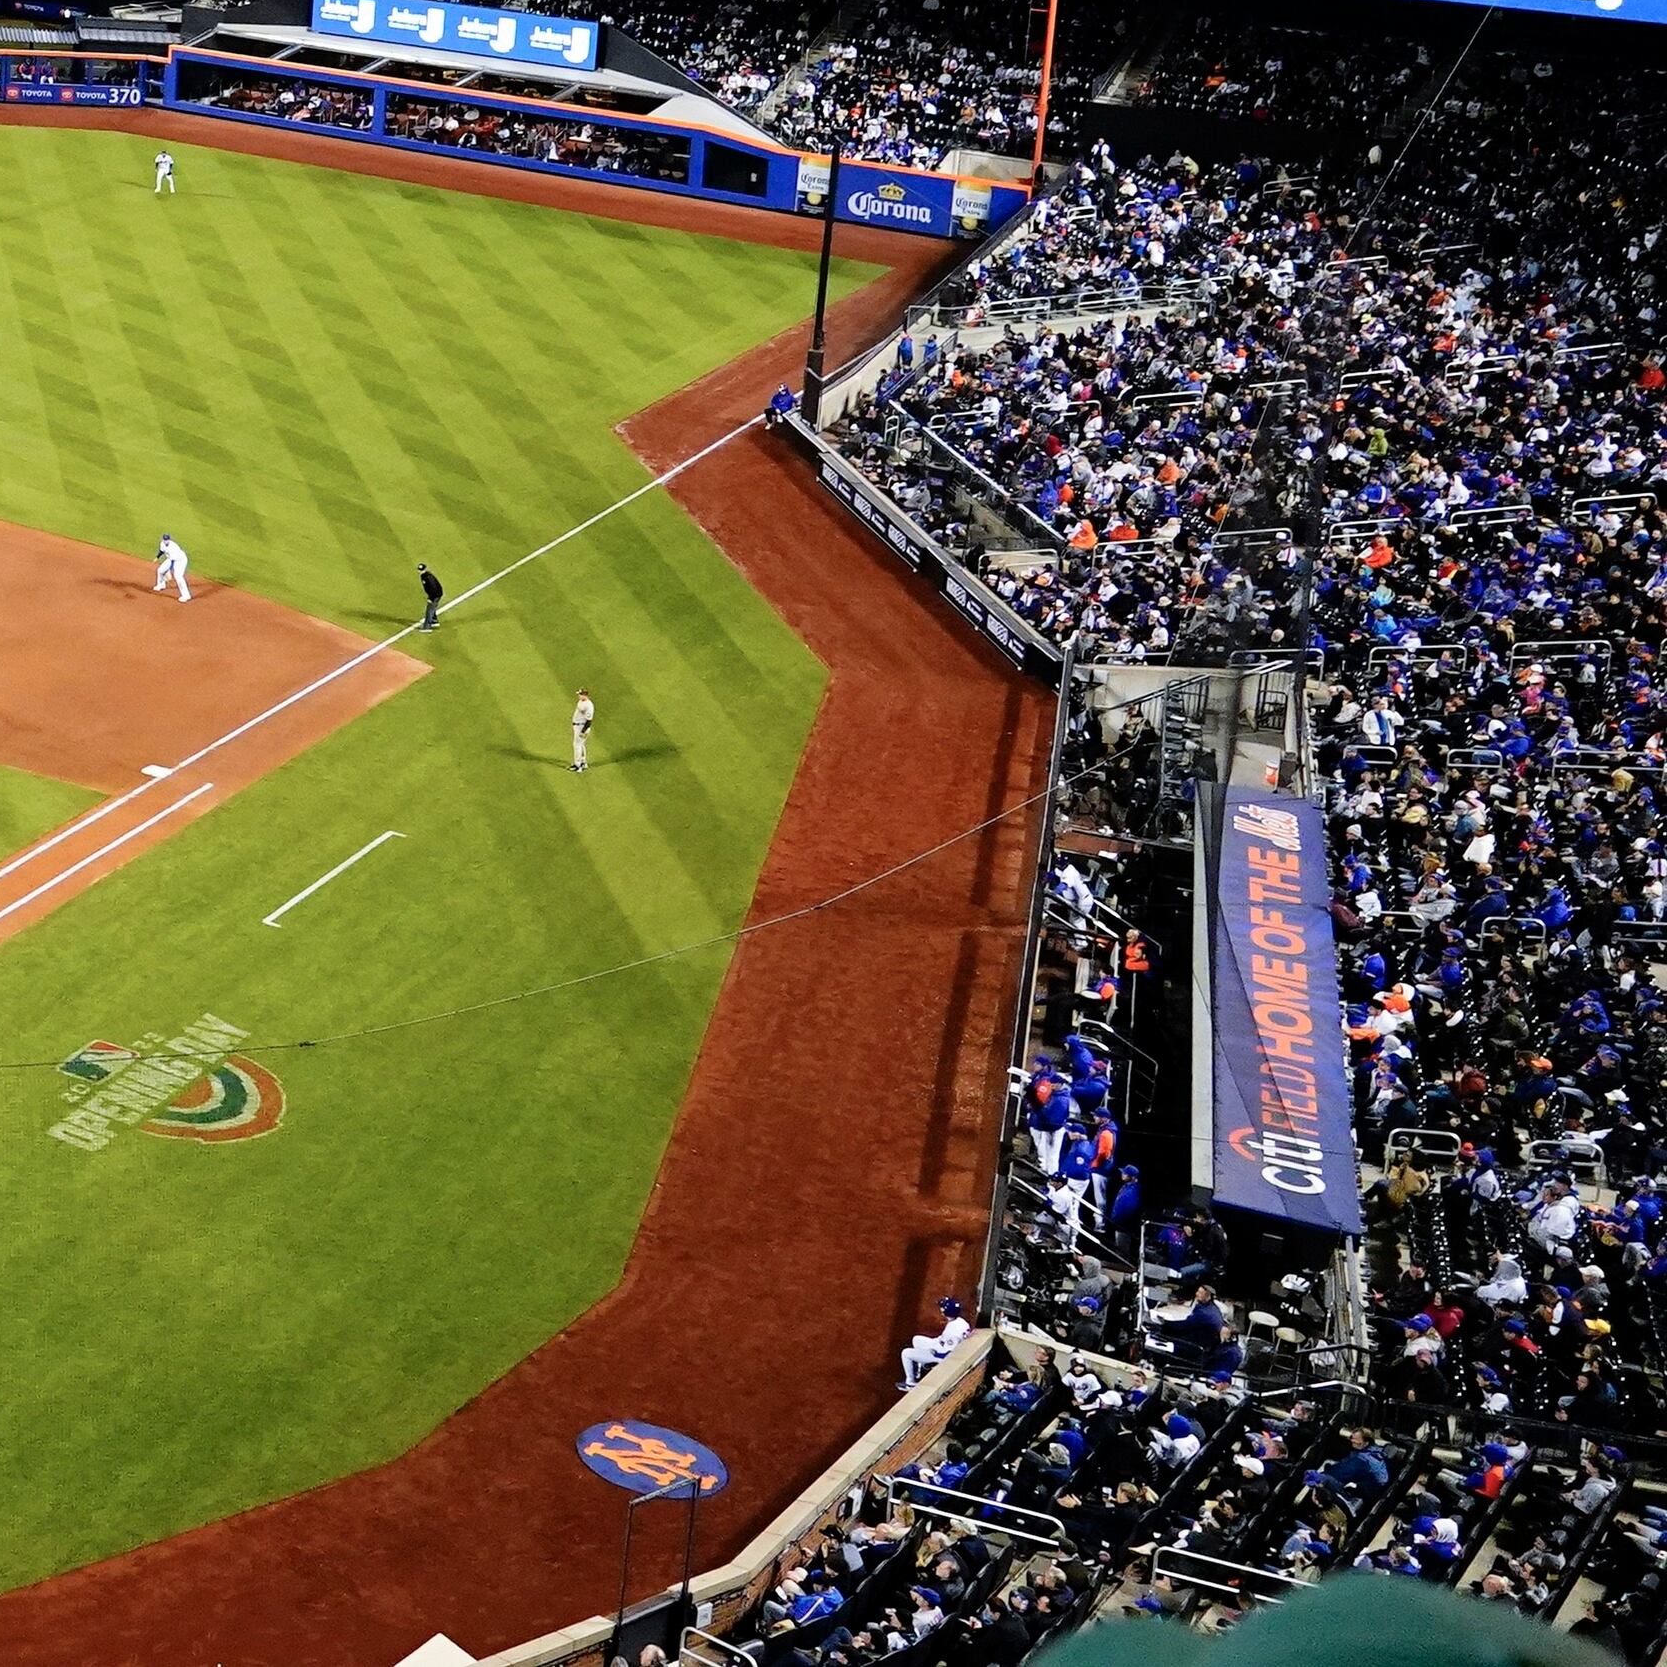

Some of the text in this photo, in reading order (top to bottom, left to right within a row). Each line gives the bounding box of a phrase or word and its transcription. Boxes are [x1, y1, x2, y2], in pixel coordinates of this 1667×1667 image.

[22, 90, 52, 98] TOYOTA
[76, 92, 106, 100] TOYOTA
[109, 88, 141, 105] 370
[847, 191, 932, 224] Corona
[1233, 804, 1327, 1195] citi FIELD HOME OF THE Mets
